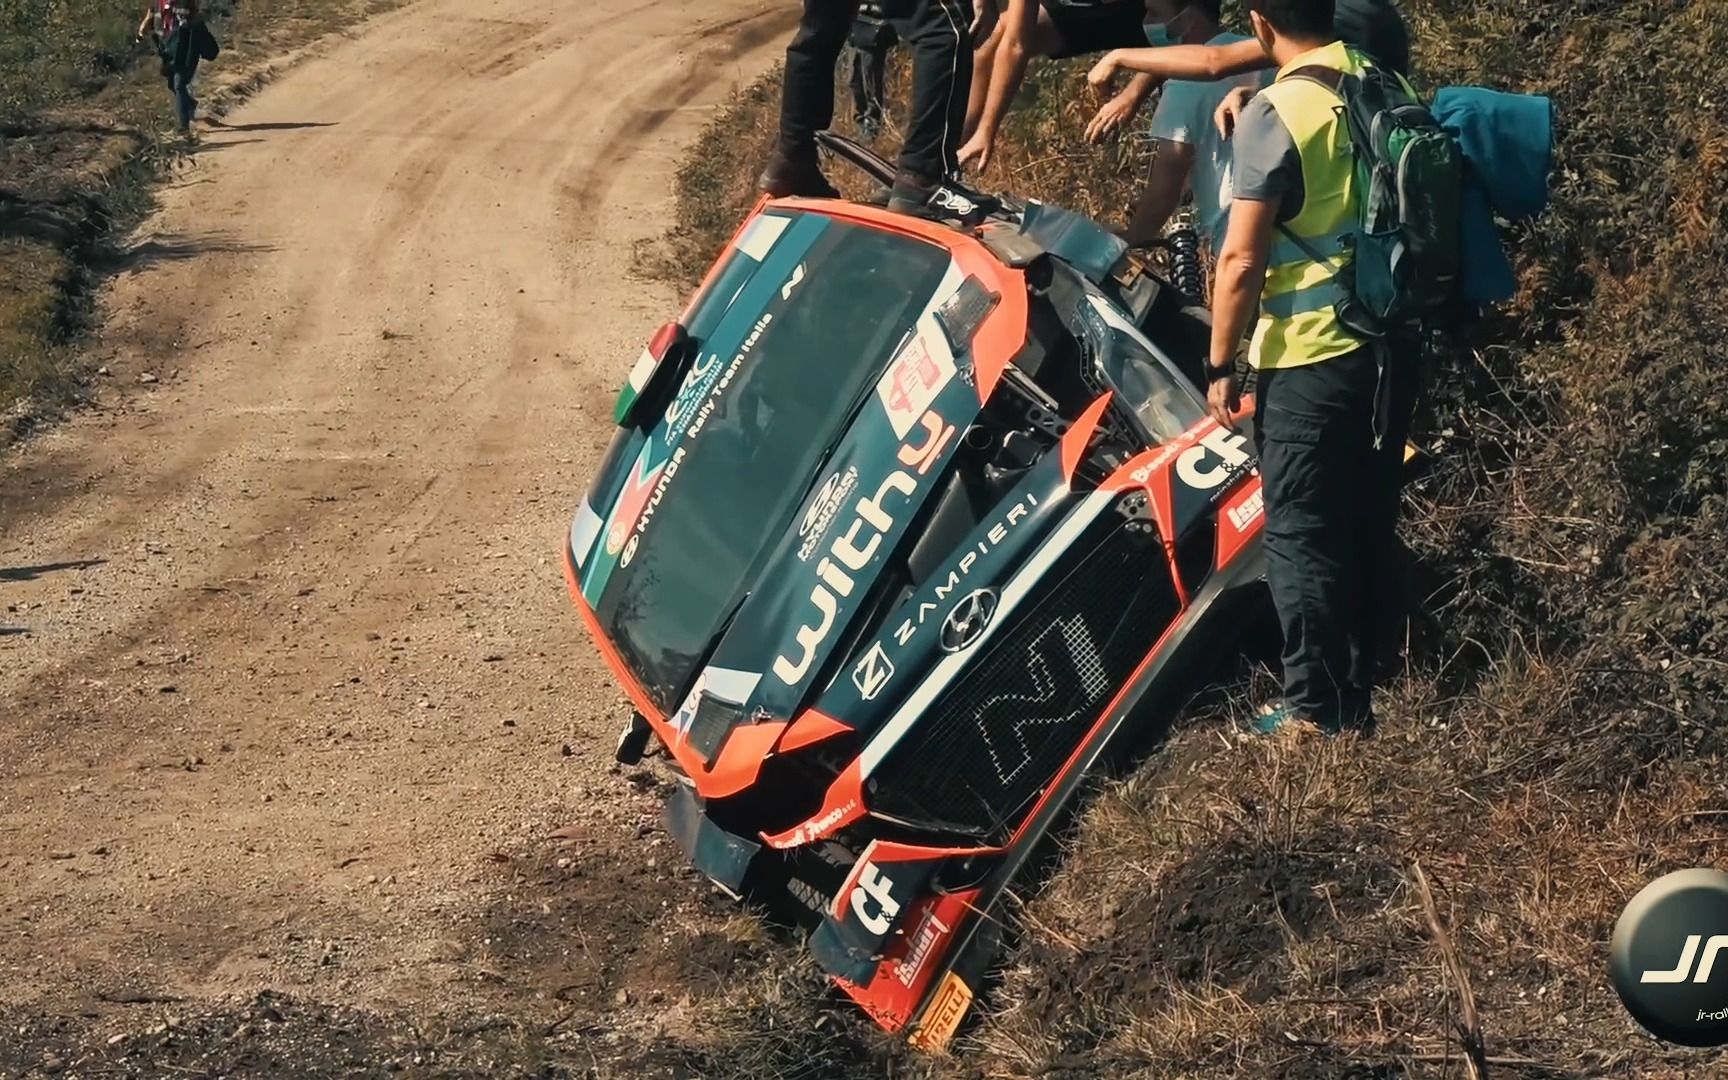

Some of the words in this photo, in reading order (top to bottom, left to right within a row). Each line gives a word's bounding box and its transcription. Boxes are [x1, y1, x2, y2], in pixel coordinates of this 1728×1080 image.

[686, 399, 715, 439] Rally
[711, 353, 745, 397] Team
[742, 312, 773, 354] Italia
[893, 493, 1038, 647] ZAMPIERI
[851, 860, 900, 935] CF
